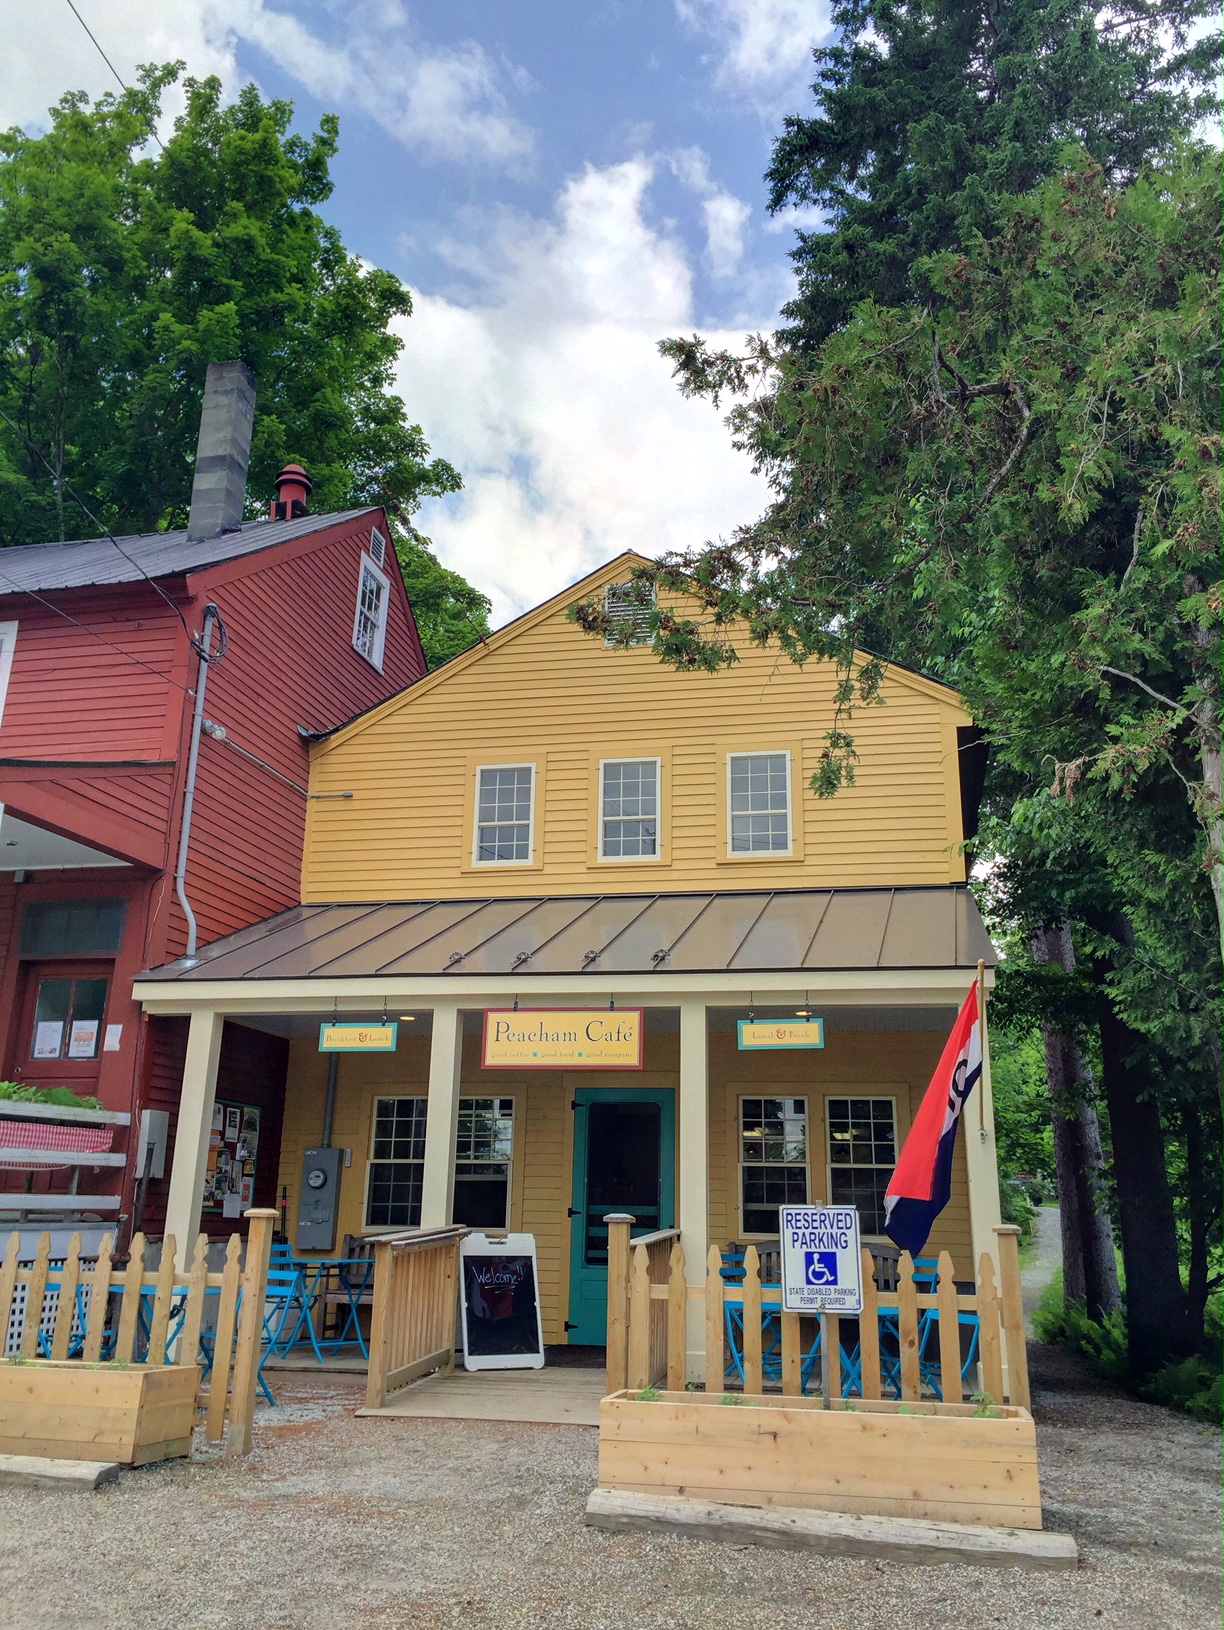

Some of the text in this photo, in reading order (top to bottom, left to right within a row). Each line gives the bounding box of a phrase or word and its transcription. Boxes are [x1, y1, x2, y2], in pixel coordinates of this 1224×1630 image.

[493, 1020, 634, 1043] Peacham Café
[752, 1028, 810, 1040] Local & Fresh
[358, 1032, 368, 1043] &
[369, 1034, 390, 1042] Lunch
[541, 1051, 557, 1059] good
[586, 1051, 603, 1059] good
[785, 1212, 853, 1230] RESERVED
[792, 1232, 849, 1250] PARKING
[789, 1287, 857, 1297] STATE DISABLED PARKING
[800, 1297, 818, 1305] PERMIT
[820, 1297, 847, 1306] REQUIRED
